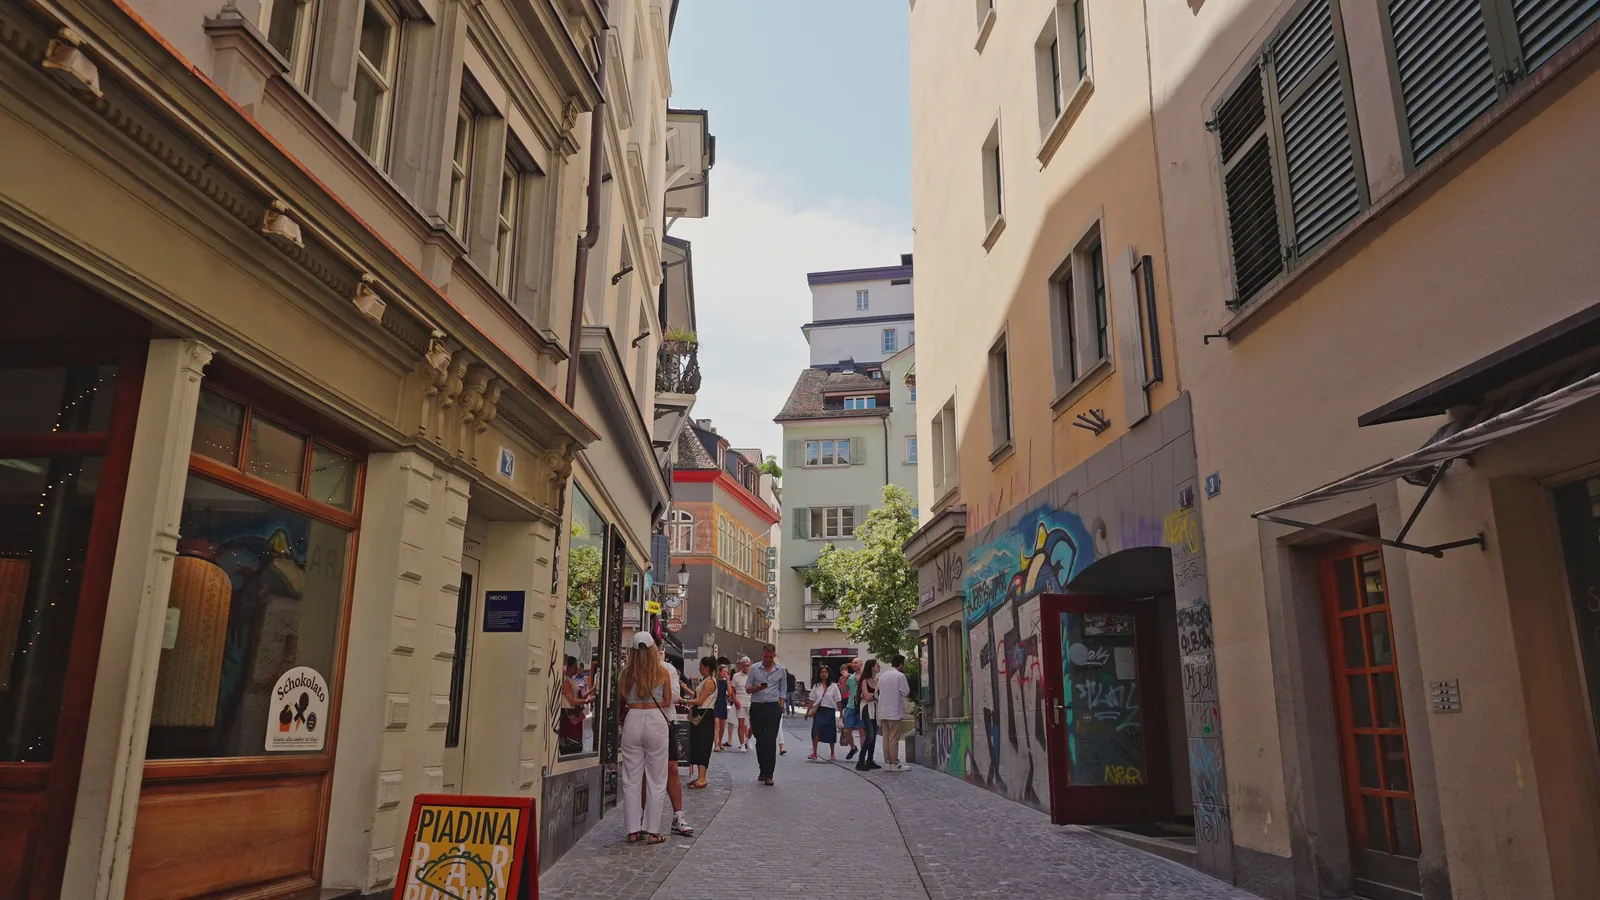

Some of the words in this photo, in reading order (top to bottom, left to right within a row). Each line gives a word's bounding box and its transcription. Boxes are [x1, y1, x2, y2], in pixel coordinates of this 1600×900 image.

[1209, 477, 1215, 492] 3
[766, 547, 775, 618] CINEMA
[277, 672, 325, 703] Schokolato
[416, 809, 513, 846] PIADINA
